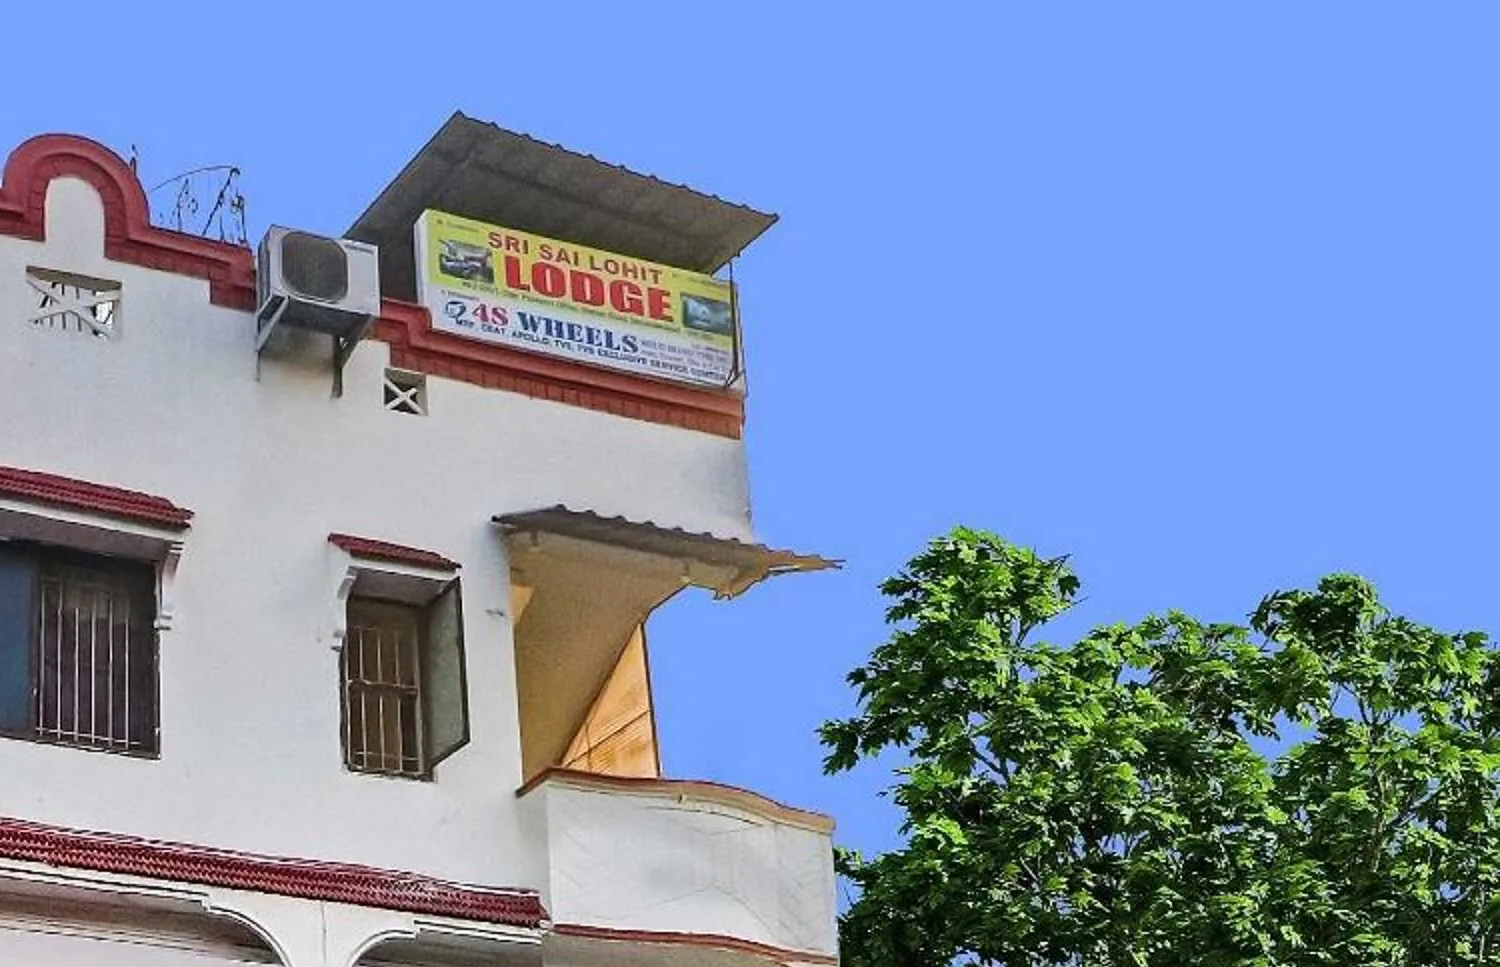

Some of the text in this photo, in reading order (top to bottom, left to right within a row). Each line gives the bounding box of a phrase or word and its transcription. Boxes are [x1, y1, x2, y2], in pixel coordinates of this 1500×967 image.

[488, 231, 529, 255] SRI
[539, 242, 580, 267] SAI
[589, 255, 663, 285] LOHIT
[504, 255, 675, 323] LODGE
[472, 302, 510, 326] 4S
[516, 310, 640, 353] WHEELS
